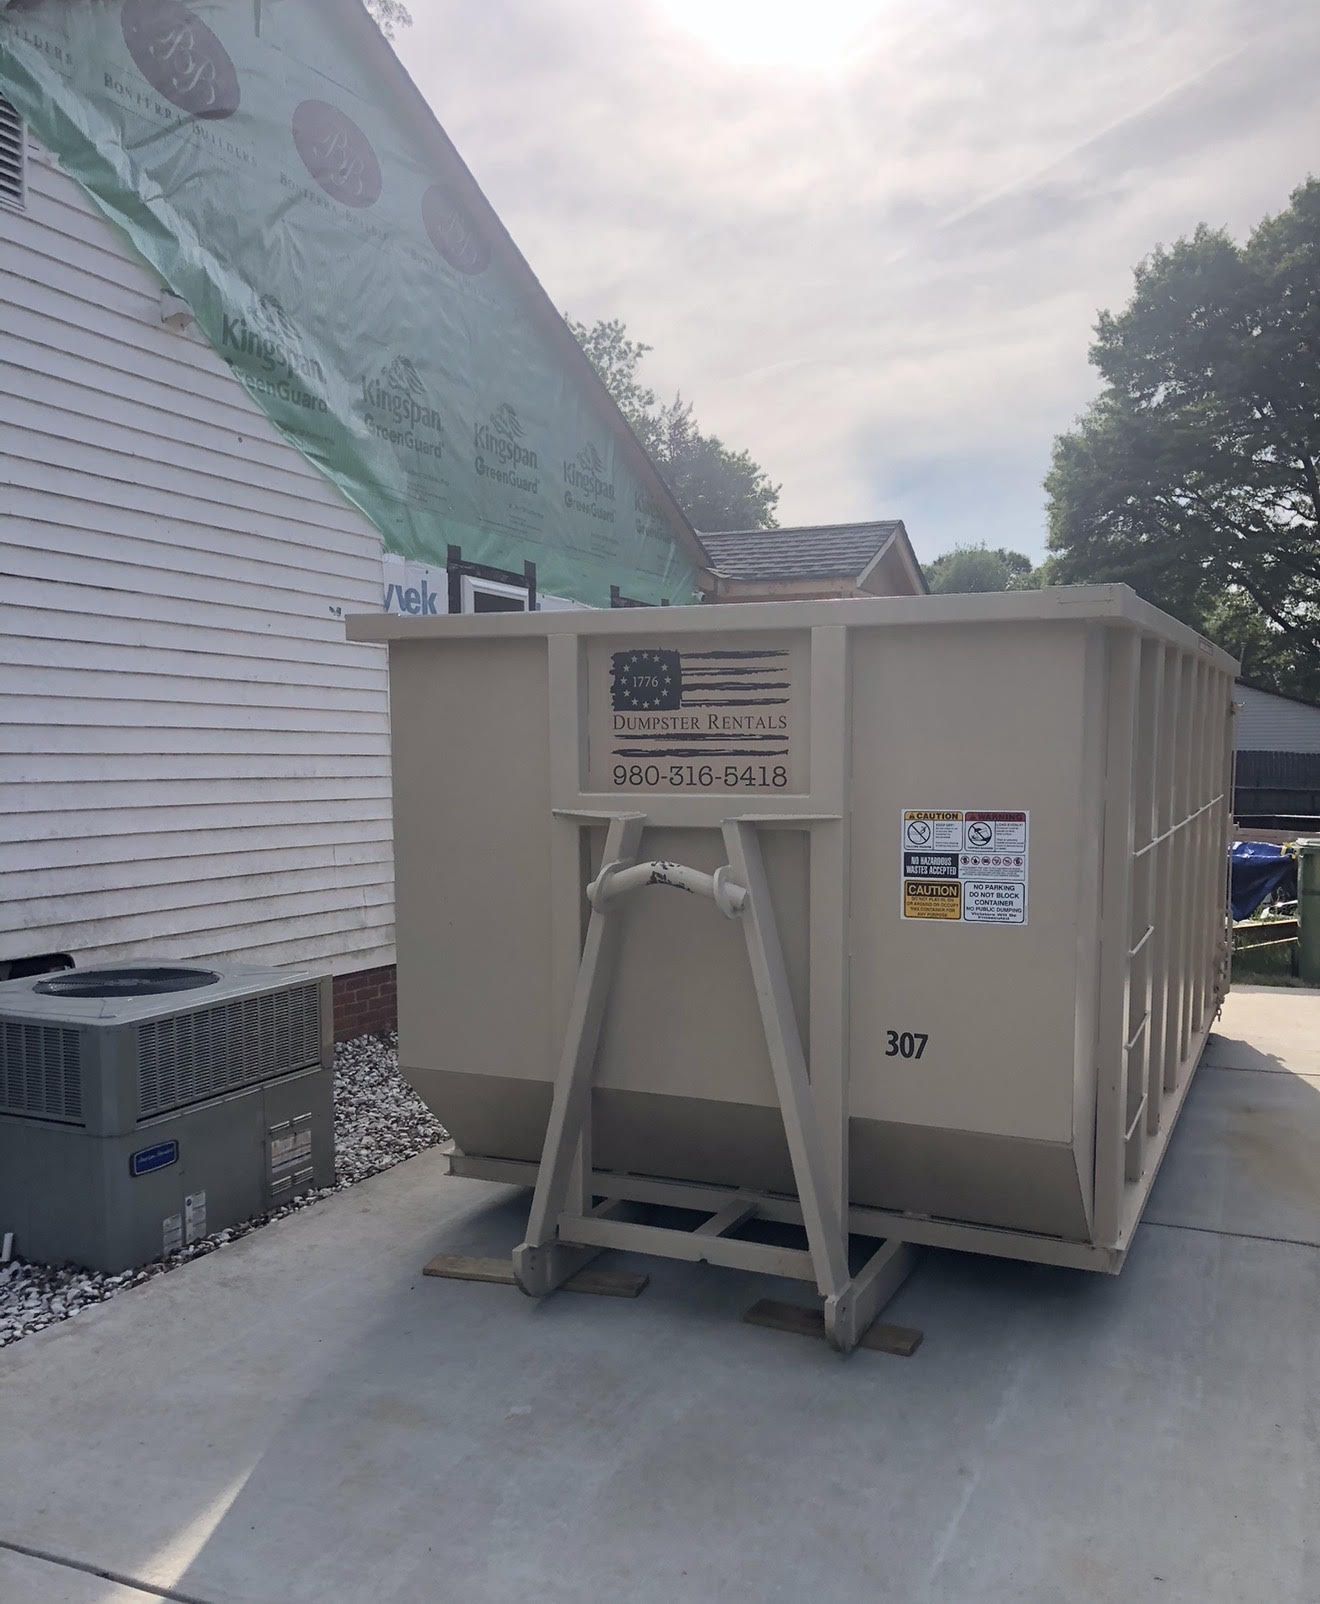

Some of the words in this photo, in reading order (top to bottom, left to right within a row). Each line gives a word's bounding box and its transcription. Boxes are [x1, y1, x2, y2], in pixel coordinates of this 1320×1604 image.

[361, 374, 443, 432] Kingspan
[473, 422, 538, 470] Kingspan
[563, 459, 616, 502] Kingspan
[632, 676, 660, 688] 1776
[613, 714, 701, 730] DUMPSTER
[707, 713, 788, 730] RENTALS
[613, 765, 788, 787] 980-316-5418
[916, 812, 959, 820] CAUTION
[911, 856, 919, 865] NO
[920, 856, 952, 866] HAZARDOUS
[906, 865, 928, 875] WASTES
[929, 865, 957, 876] ACCEPTED
[908, 884, 957, 896] CAUTION
[974, 899, 1014, 907] CONTAINER
[885, 1030, 929, 1059] 307
